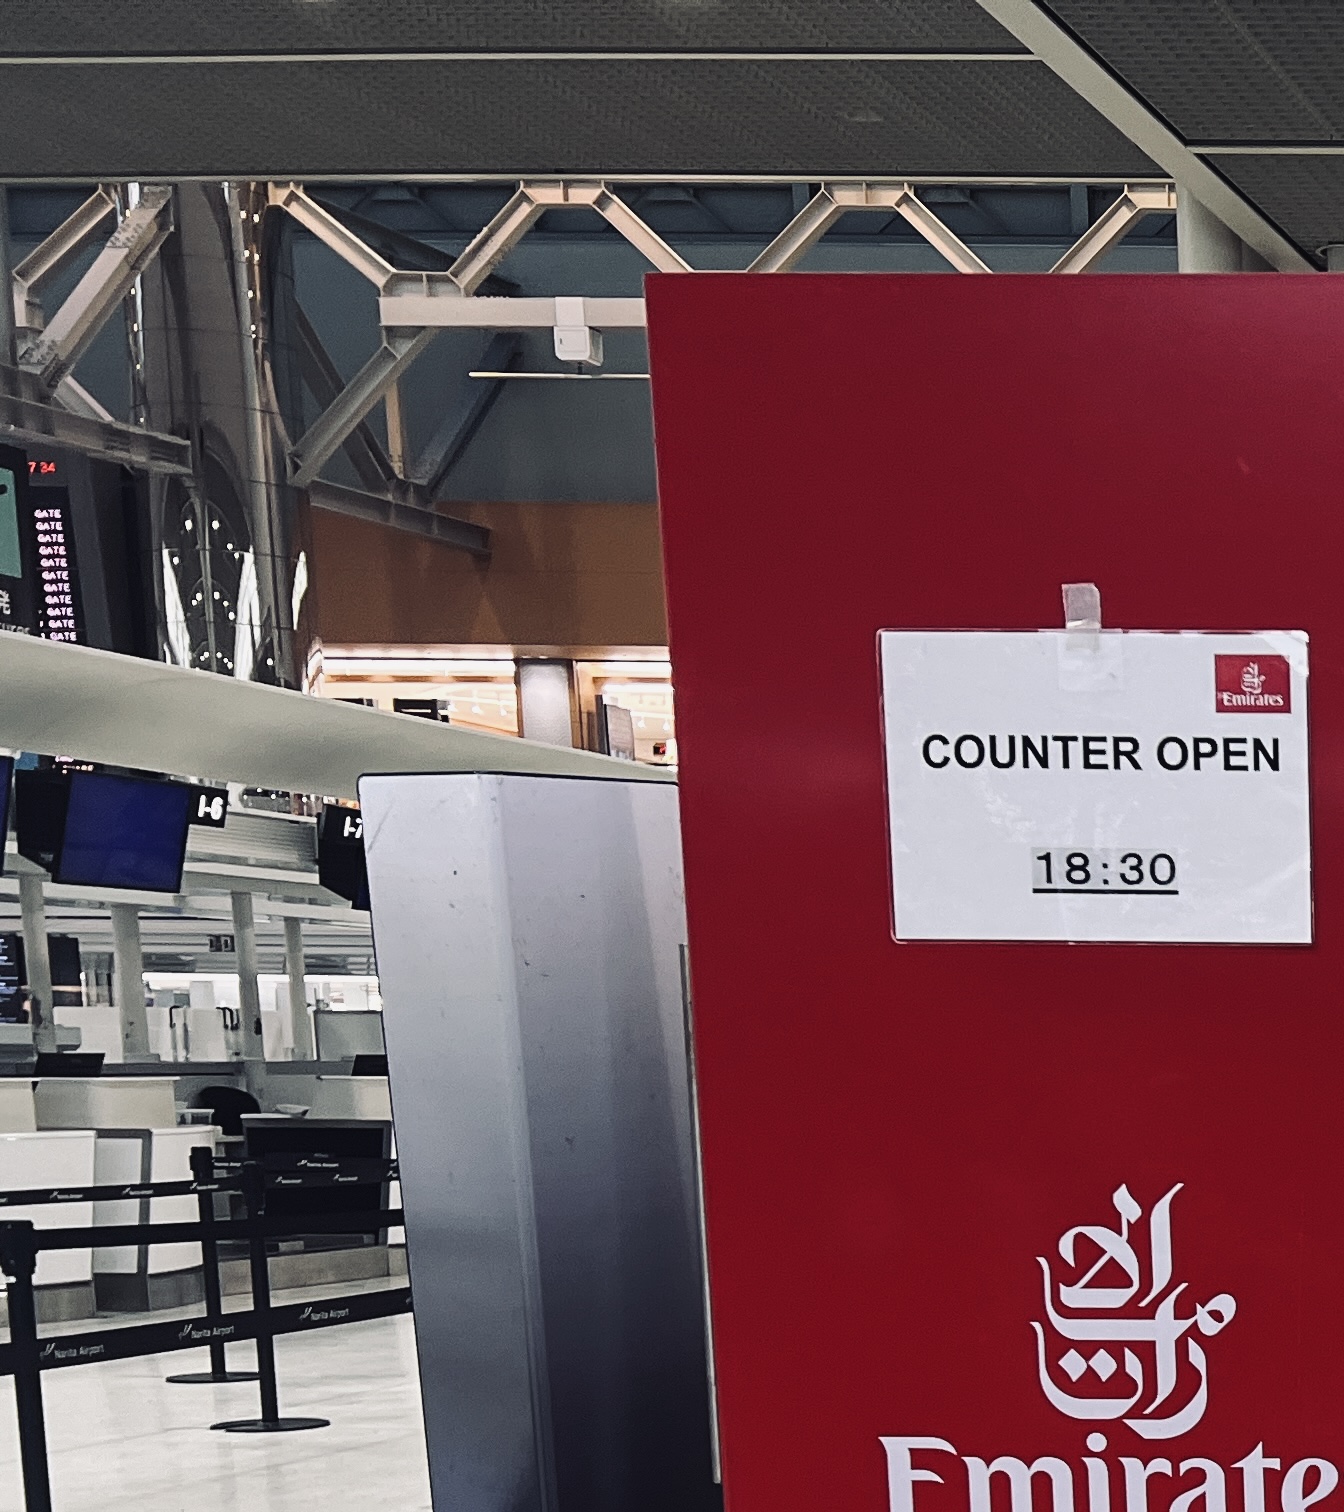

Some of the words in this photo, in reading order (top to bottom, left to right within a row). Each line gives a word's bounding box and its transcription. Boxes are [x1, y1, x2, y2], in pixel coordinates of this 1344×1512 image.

[34, 509, 61, 518] GATE
[36, 521, 62, 531] GATE
[37, 533, 64, 543] GATE
[39, 546, 66, 555] GATE
[40, 558, 67, 567] GATE
[42, 571, 69, 580] GATE
[43, 583, 70, 592] GATE
[45, 595, 72, 604] GATE
[47, 607, 74, 617] GATE
[48, 619, 75, 629] GATE
[50, 631, 77, 641] GATE
[1222, 691, 1284, 707] Emirates
[922, 734, 1143, 770] COUNTER
[1156, 736, 1281, 772] OPEN
[1036, 852, 1176, 885] 18:30
